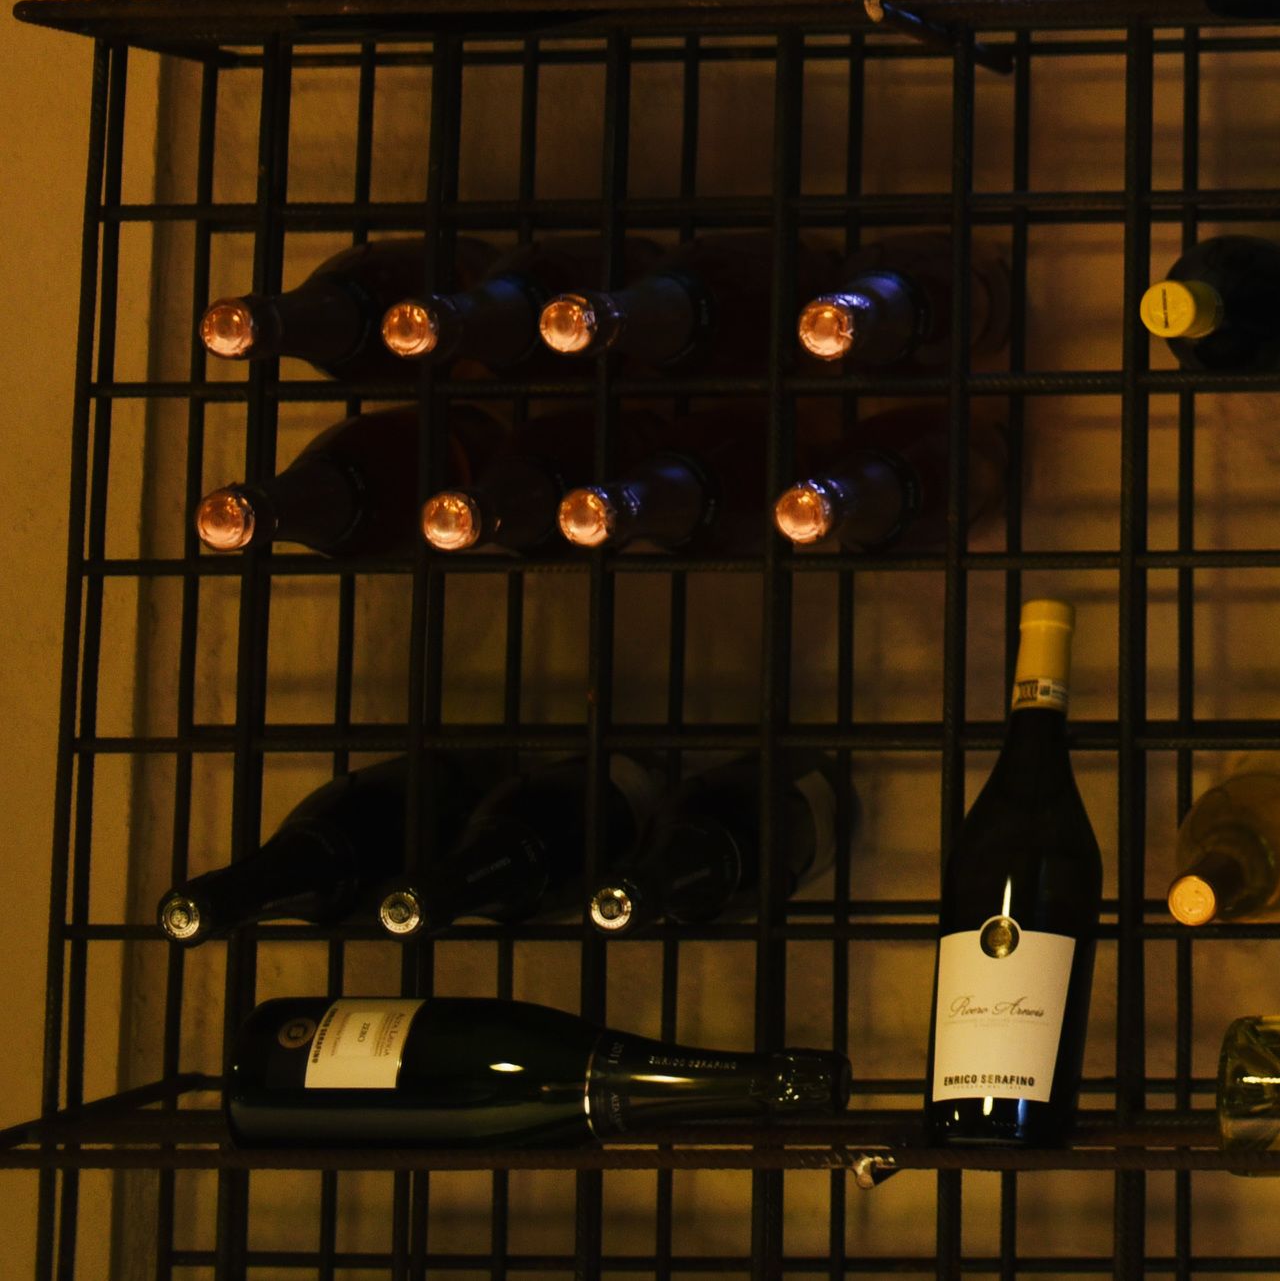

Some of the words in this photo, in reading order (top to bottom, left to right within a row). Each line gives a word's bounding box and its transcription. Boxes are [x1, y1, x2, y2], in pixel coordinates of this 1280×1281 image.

[948, 995, 989, 1018] Roero
[311, 1029, 328, 1064] SERAFINO
[943, 1074, 978, 1087] ENRICO
[980, 1074, 1036, 1087] SERAFINO
